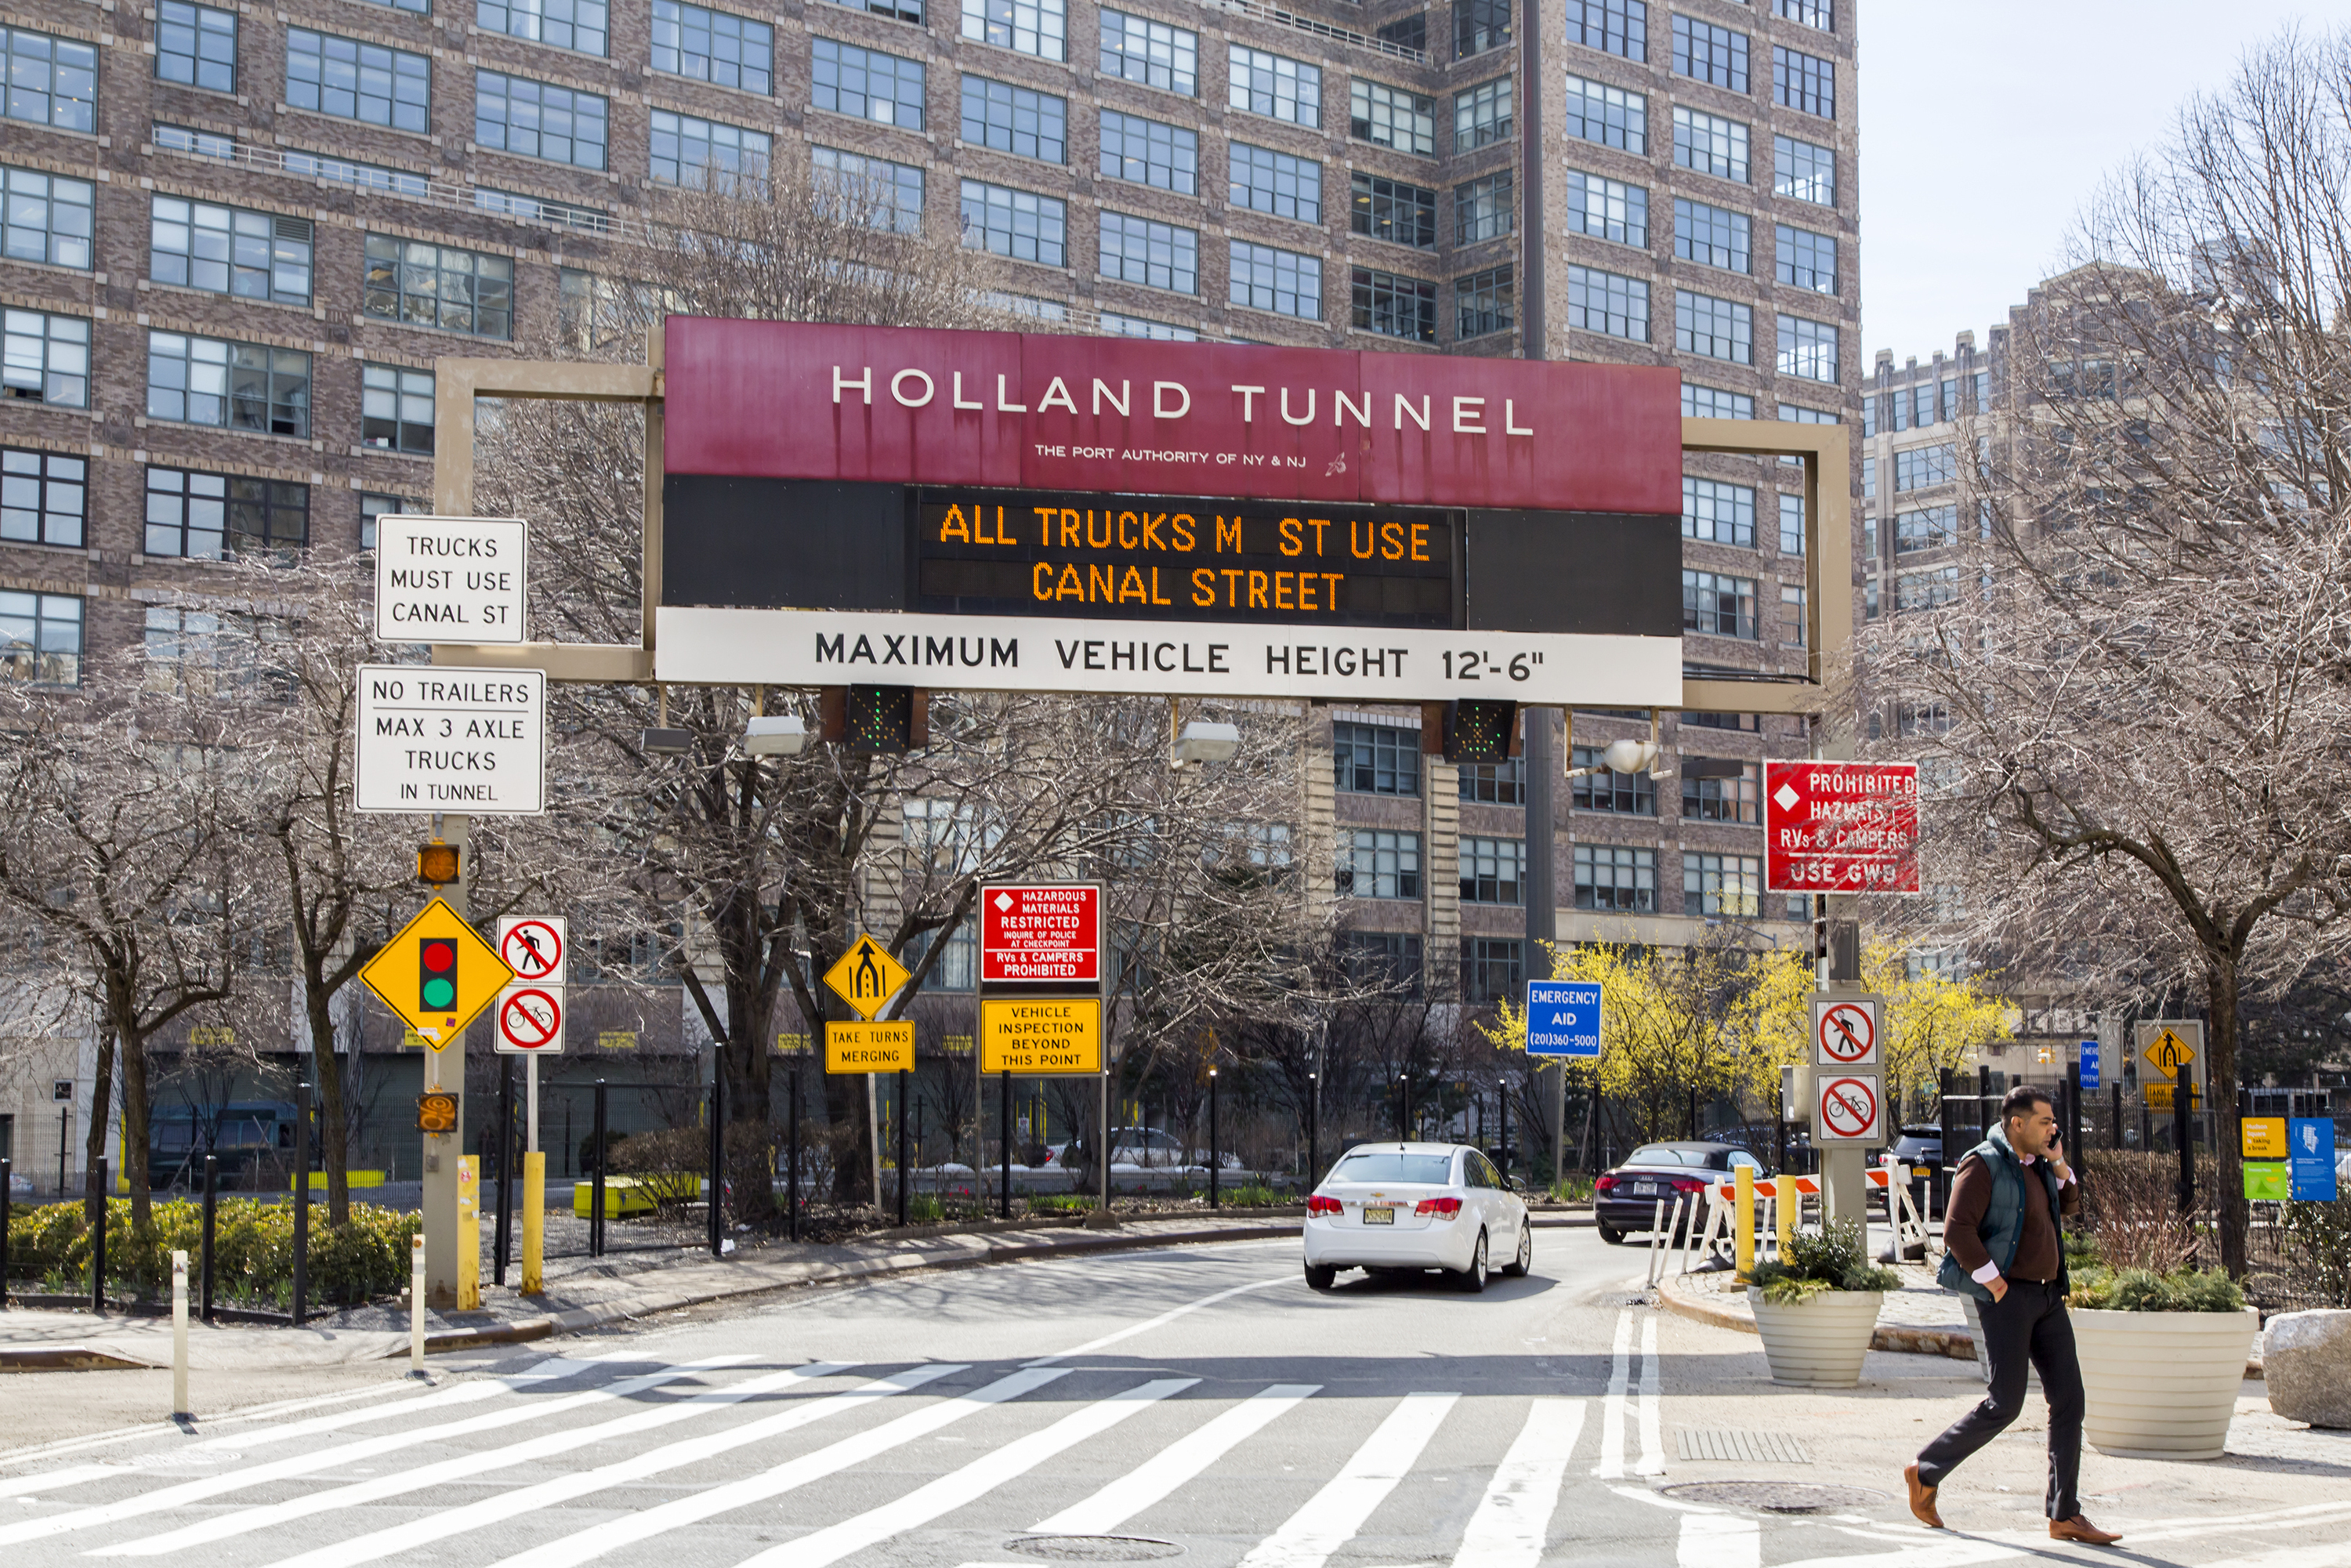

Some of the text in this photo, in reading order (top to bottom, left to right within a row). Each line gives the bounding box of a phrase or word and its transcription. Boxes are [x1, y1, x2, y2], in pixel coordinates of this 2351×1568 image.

[833, 366, 1533, 435] HOLLAND TUNNEL
[1035, 445, 1306, 467] THE PORT AUTHORITY OF NY & NJ
[940, 504, 1016, 545] ALL
[1034, 507, 1195, 552] TRUCKS
[1351, 521, 1429, 561] USE
[408, 537, 497, 557] TRUCKS
[392, 570, 510, 590] MUST USE
[1034, 562, 1343, 610] CANAL STREET
[393, 603, 509, 623] CANAL ST
[817, 633, 1543, 681] MAXIMUM VEHICLE HEIGHT 12'-6"
[374, 681, 528, 703] NO TRAILERS
[377, 718, 523, 738] MAX 3 AXLE
[405, 751, 495, 770] TRUCKS
[401, 784, 498, 800] IN TUNNEL
[1810, 774, 1914, 794] PROHIBITED
[1781, 829, 1909, 849] RVs & CAMPERS
[1791, 864, 1896, 882] USE GWB
[1023, 891, 1086, 901] HAZARDOUS
[1023, 904, 1079, 914] MATERIALS
[1002, 916, 1079, 928] RESTRICTED
[997, 953, 1083, 962] RVs & CAMPERS
[1005, 965, 1075, 976] PROHIBITED
[1532, 990, 1597, 1005] EMERGENCY
[1012, 1007, 1070, 1017] VEHICLE
[1552, 1012, 1576, 1025] AID
[999, 1023, 1083, 1034] INSPECTION
[834, 1031, 907, 1043] TAKE TURNS
[1012, 1039, 1070, 1049] BEYOND
[1531, 1032, 1596, 1046] (201)360-5000
[842, 1051, 899, 1062] MERGING
[1002, 1055, 1081, 1065] THIS POINT
